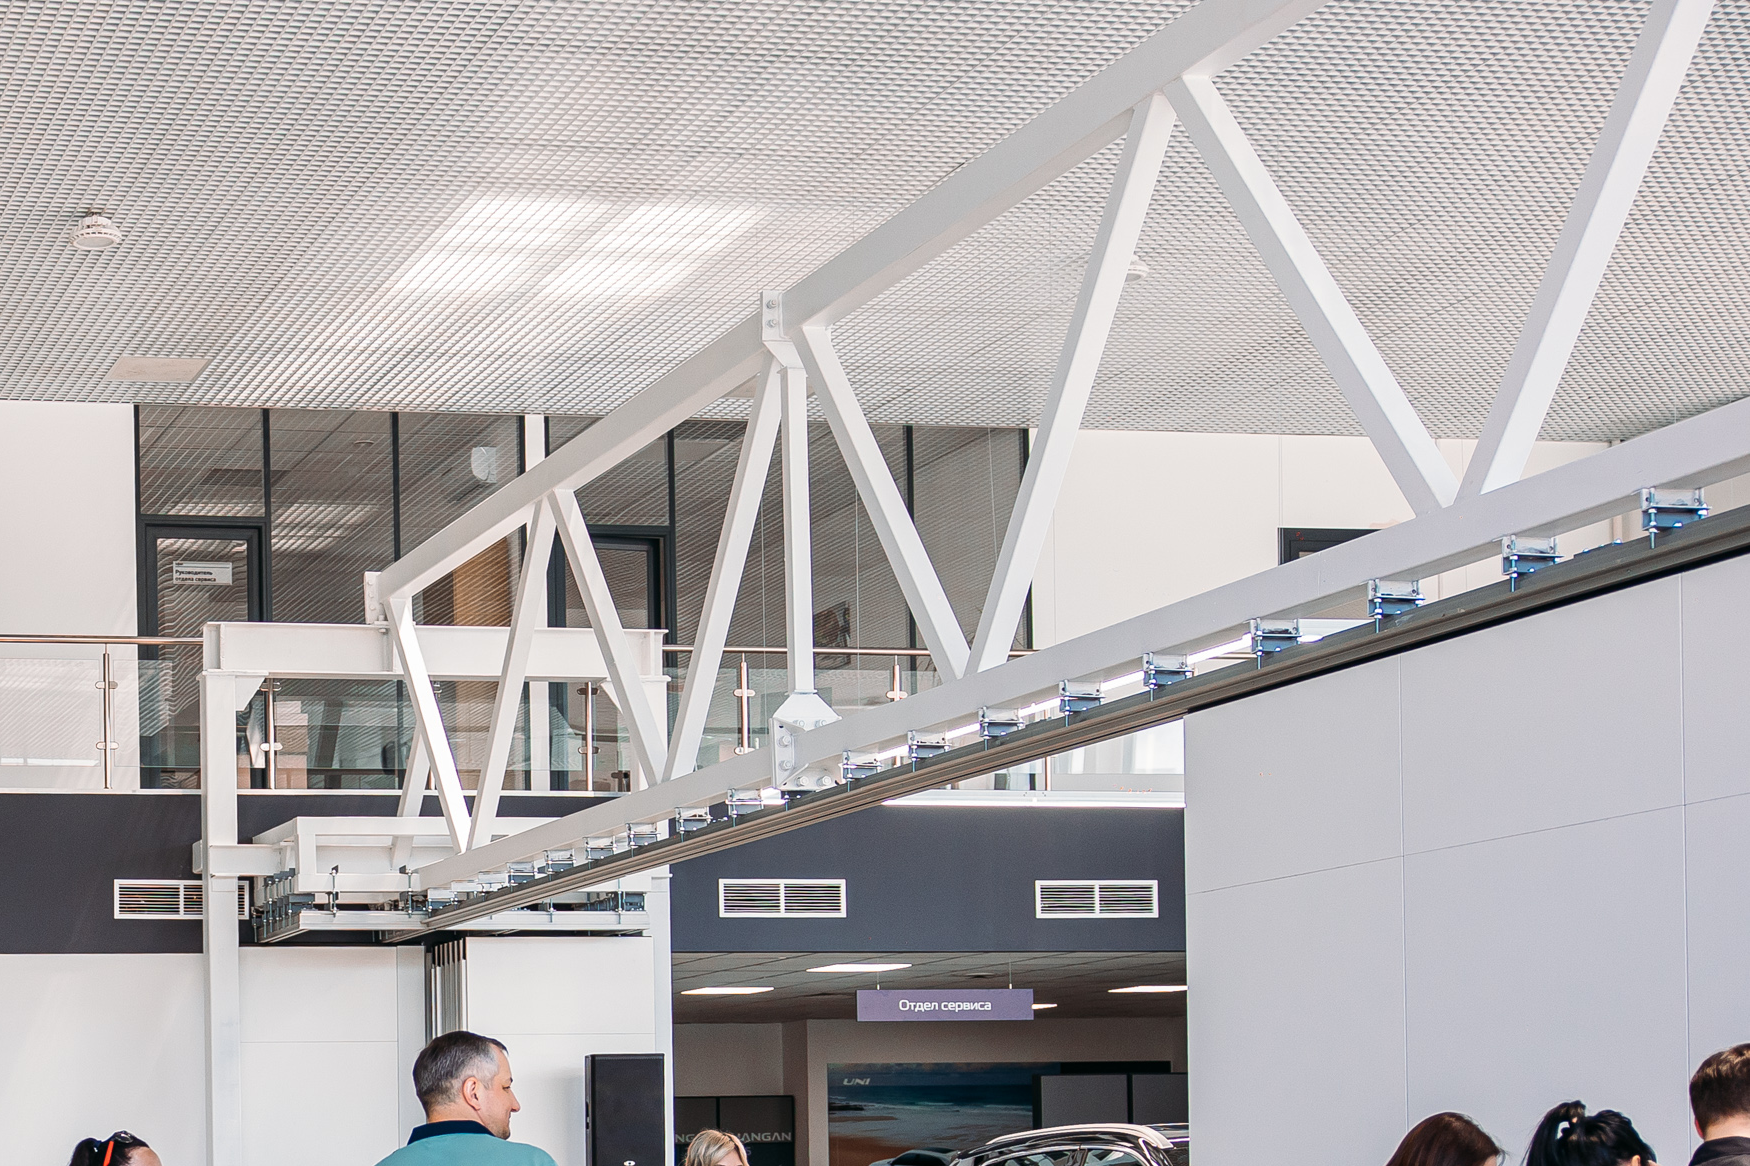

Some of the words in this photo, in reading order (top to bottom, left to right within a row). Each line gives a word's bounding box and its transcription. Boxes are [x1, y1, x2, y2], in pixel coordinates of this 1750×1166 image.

[899, 1000, 938, 1012] Отдел
[941, 1001, 991, 1012] сервиса
[843, 1077, 871, 1086] UNI
[737, 1132, 791, 1141] ANGAN
